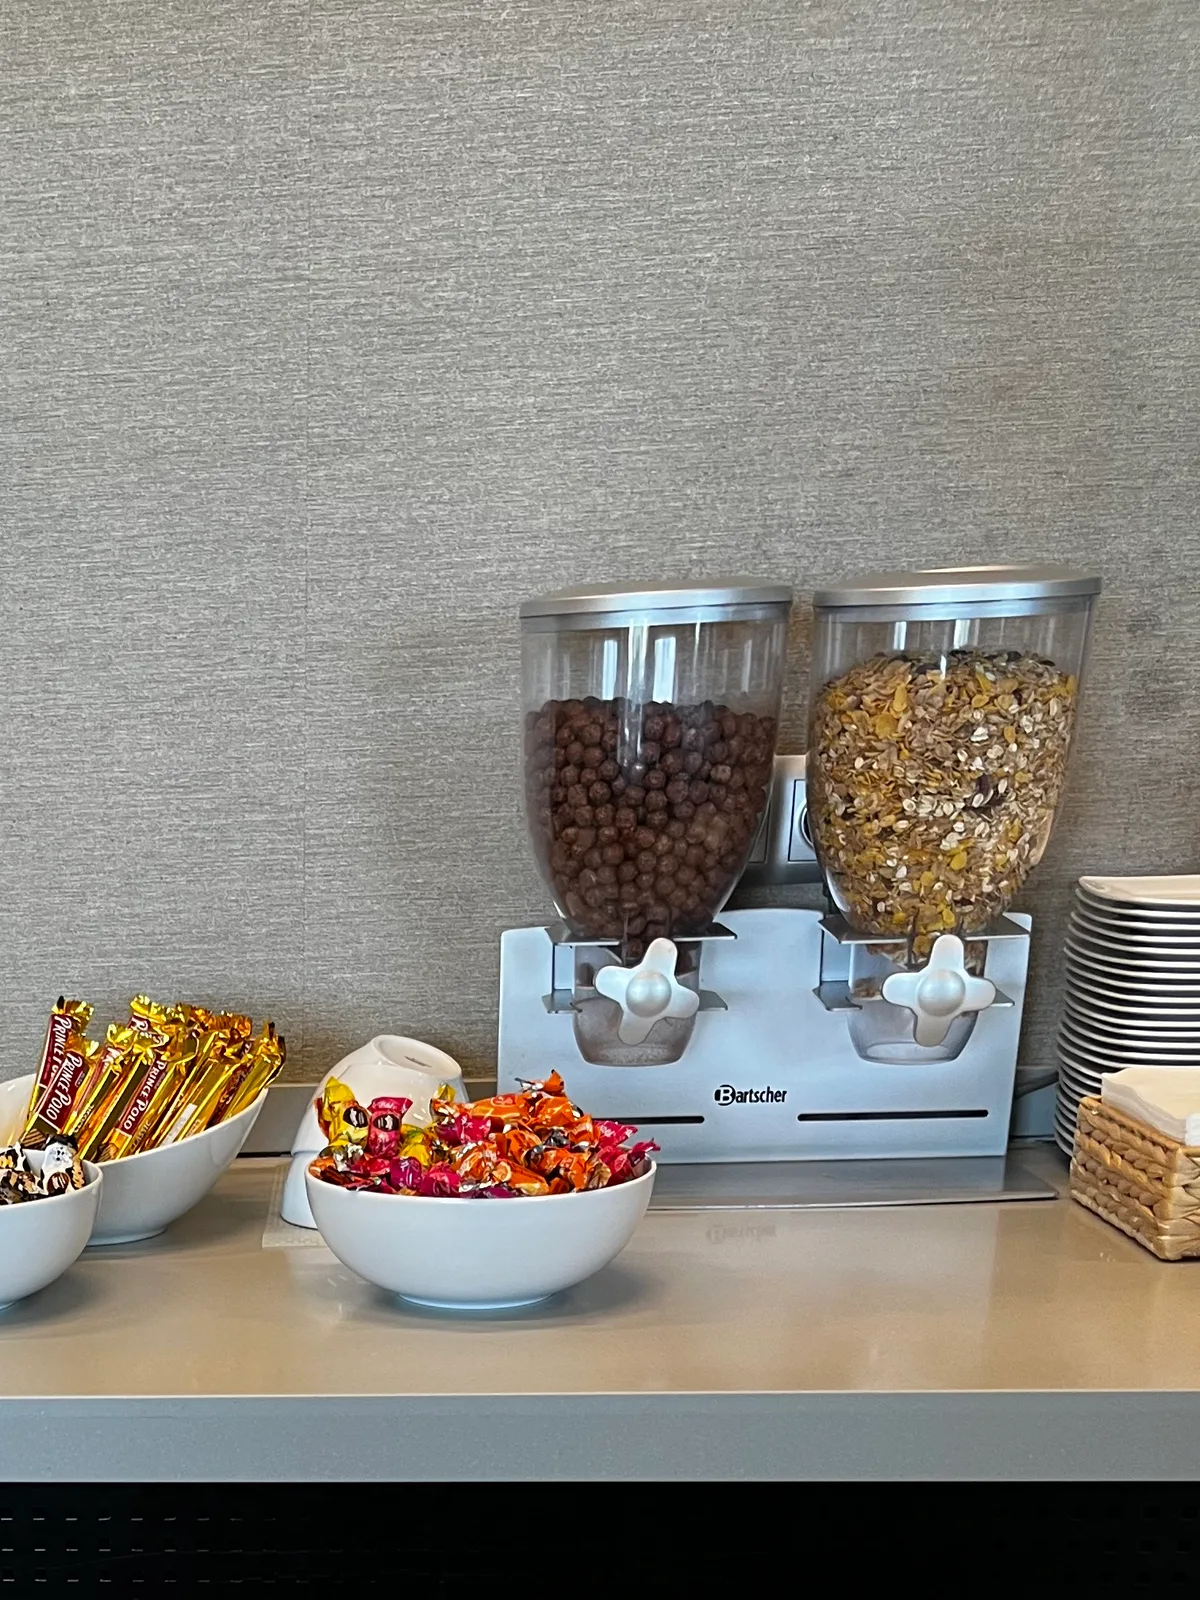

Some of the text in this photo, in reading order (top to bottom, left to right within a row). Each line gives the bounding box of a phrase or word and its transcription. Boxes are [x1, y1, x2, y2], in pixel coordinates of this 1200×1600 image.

[61, 1052, 83, 1094] PRINCE
[139, 1060, 167, 1100] PRINCE
[46, 1089, 72, 1121] POLO
[714, 1084, 788, 1106] Bartscher
[123, 1098, 149, 1130] POLO
